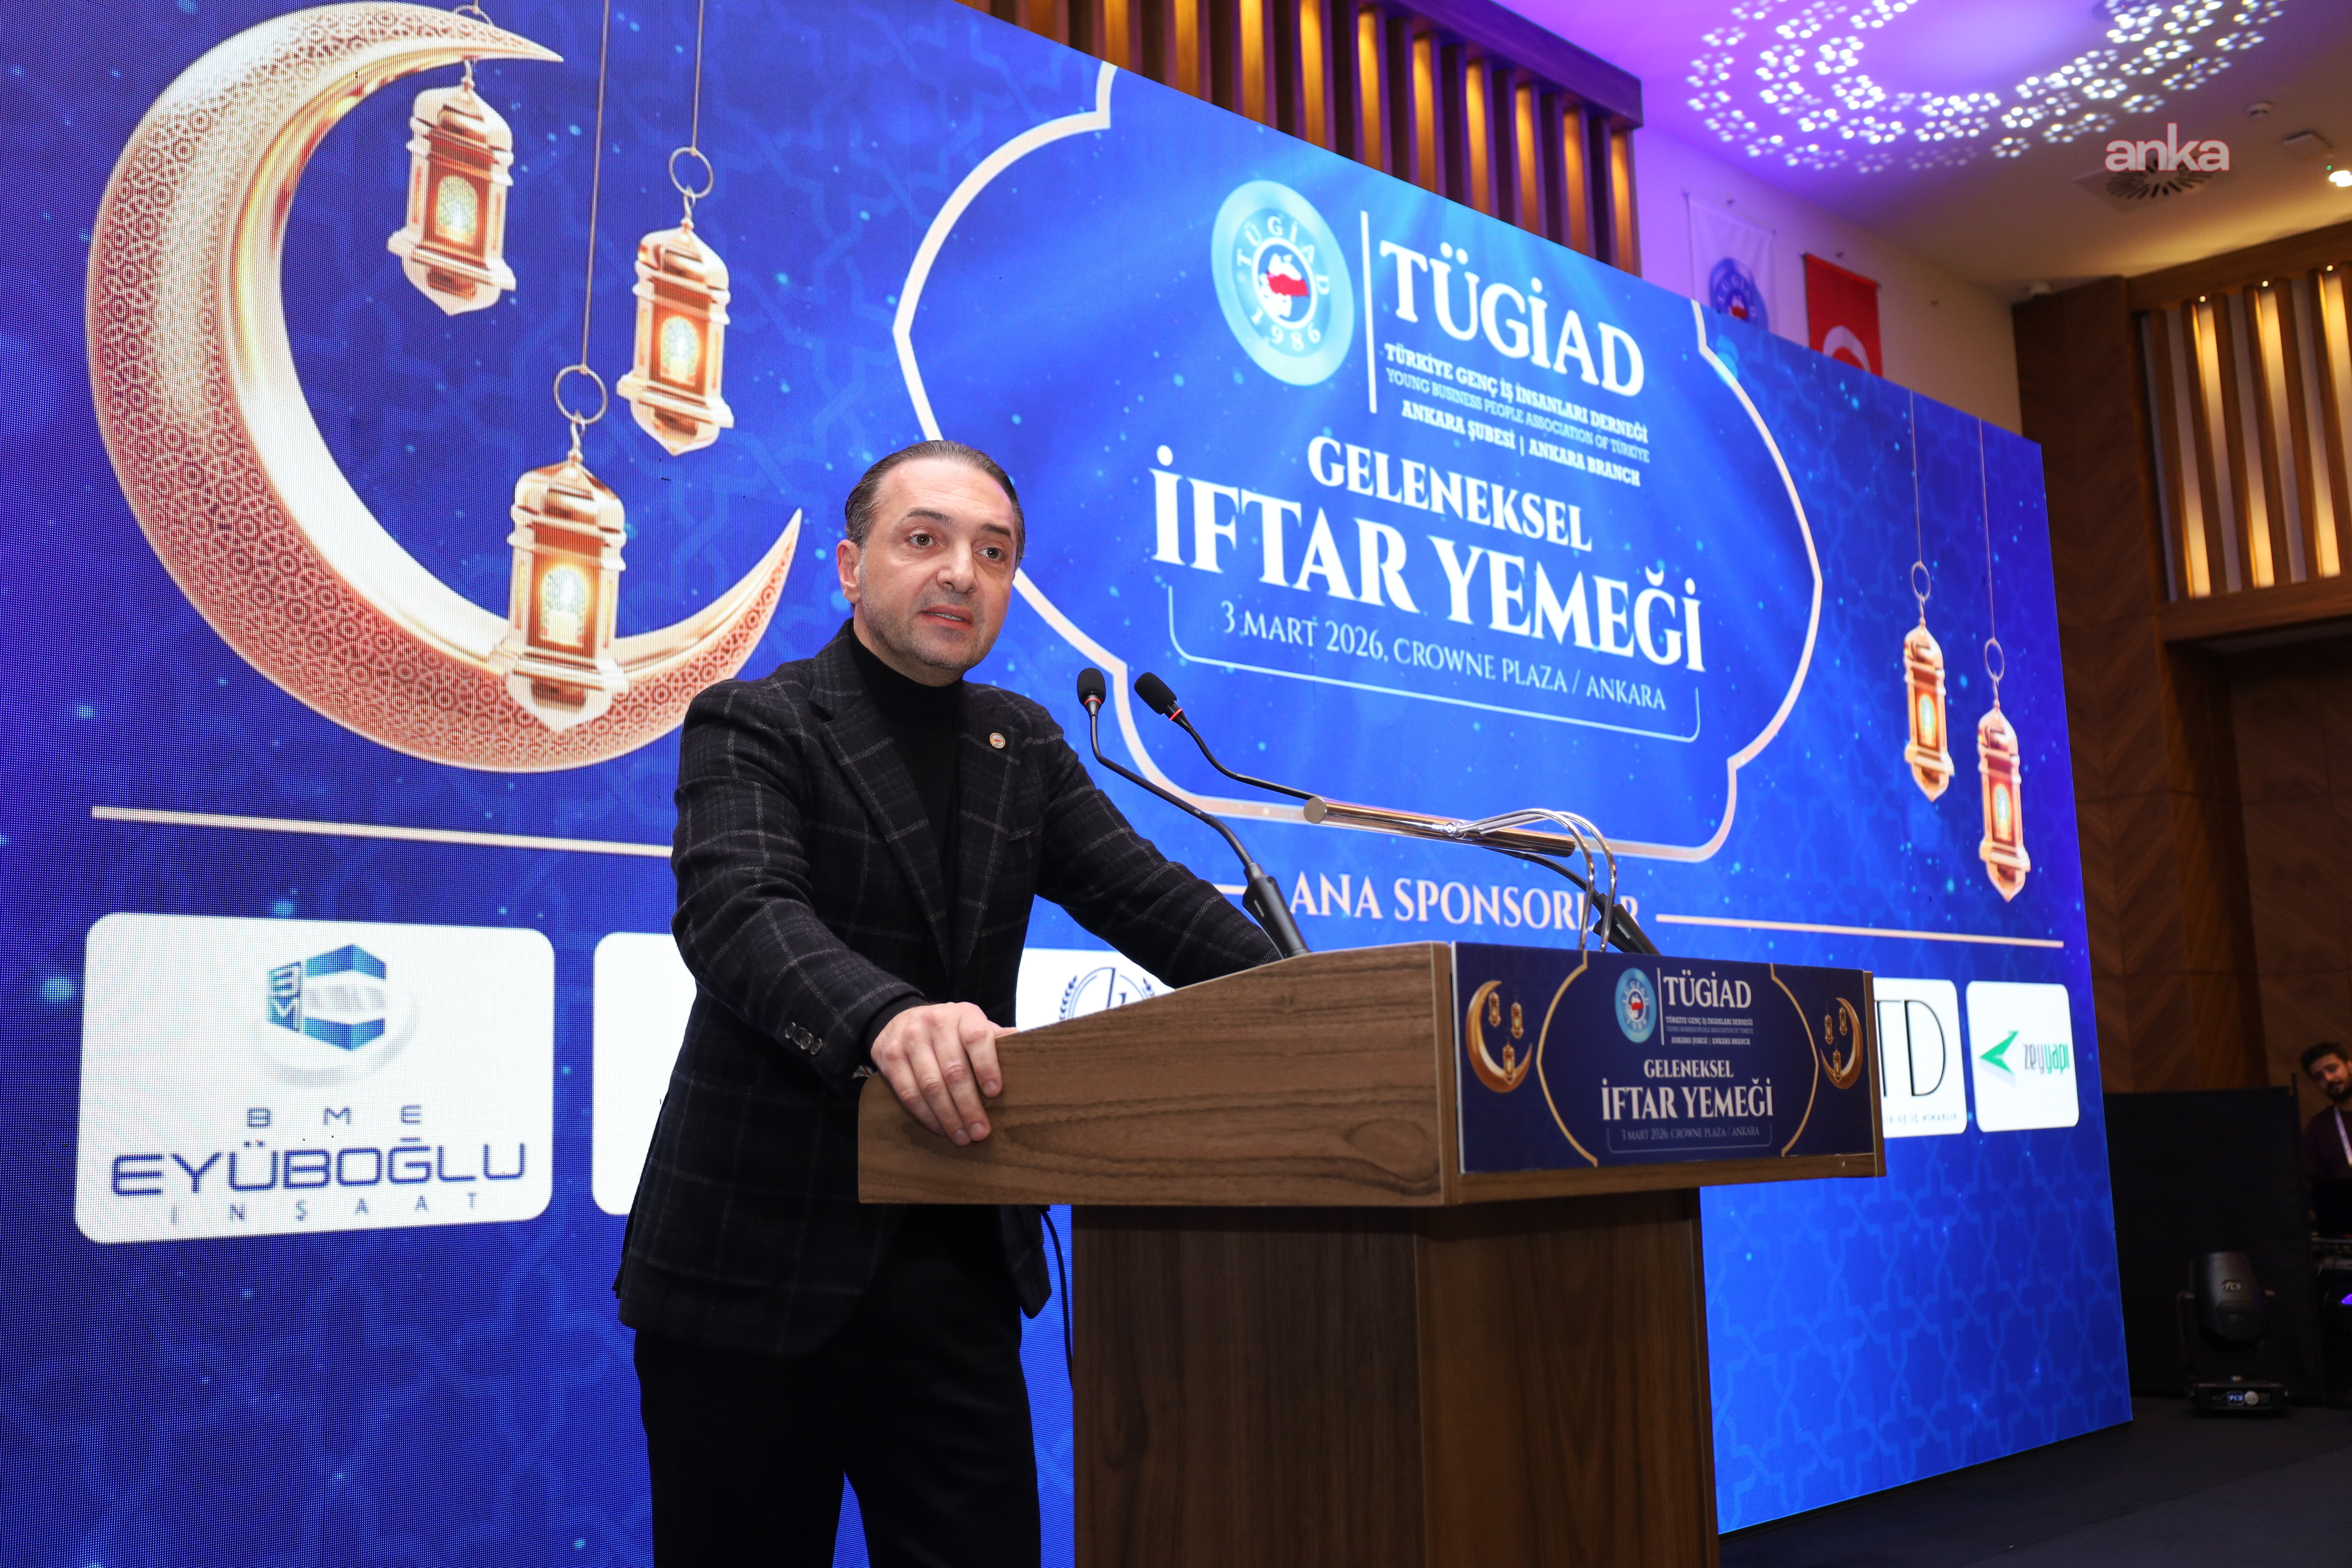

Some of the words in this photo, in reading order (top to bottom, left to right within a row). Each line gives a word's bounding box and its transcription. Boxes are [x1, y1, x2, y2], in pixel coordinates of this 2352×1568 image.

[1251, 307, 1321, 352] 1986
[1380, 240, 1645, 397] TÜGİAD
[1384, 343, 1453, 380] TÜRKİYE
[1456, 367, 1498, 398] GENÇ
[1501, 377, 1513, 404] İŞ
[1515, 382, 1589, 424] İNSANLARI
[1590, 407, 1649, 444] DERNEĞİ
[1386, 368, 1430, 394] YOUNG
[1432, 381, 1483, 411] BUSINESS
[1484, 399, 1524, 424] PEOPLE
[1526, 412, 1594, 445] ASSOCIATION
[1595, 435, 1609, 450] OF
[1402, 400, 1466, 435] ANKARA
[1467, 420, 1516, 450] ŞUBESİ
[1529, 438, 1586, 471] ANKARA
[1587, 456, 1641, 487] BRANCH
[1308, 436, 1592, 551] GELENEKSEL
[1148, 445, 1421, 614] İFTAR
[1426, 535, 1706, 672] YEMEĞİ
[1221, 600, 1236, 633] 3
[1244, 610, 1318, 647] MART
[1325, 620, 1388, 663] 2026,
[1393, 637, 1496, 680] CROWNE
[1502, 657, 1568, 693] PLAZA
[1586, 675, 1666, 710] ANKARA
[1290, 870, 1383, 919] ANA
[1663, 969, 1752, 1009] TÜGİAD
[1601, 1077, 1678, 1120] İFTAR
[1680, 1077, 1774, 1118] YEMEĞİ
[1643, 1059, 1734, 1078] GELENEKSEL
[247, 1104, 422, 1128] BME
[1732, 1125, 1760, 1136] ANKARA
[112, 1136, 526, 1196] EYÜBOĞLU
